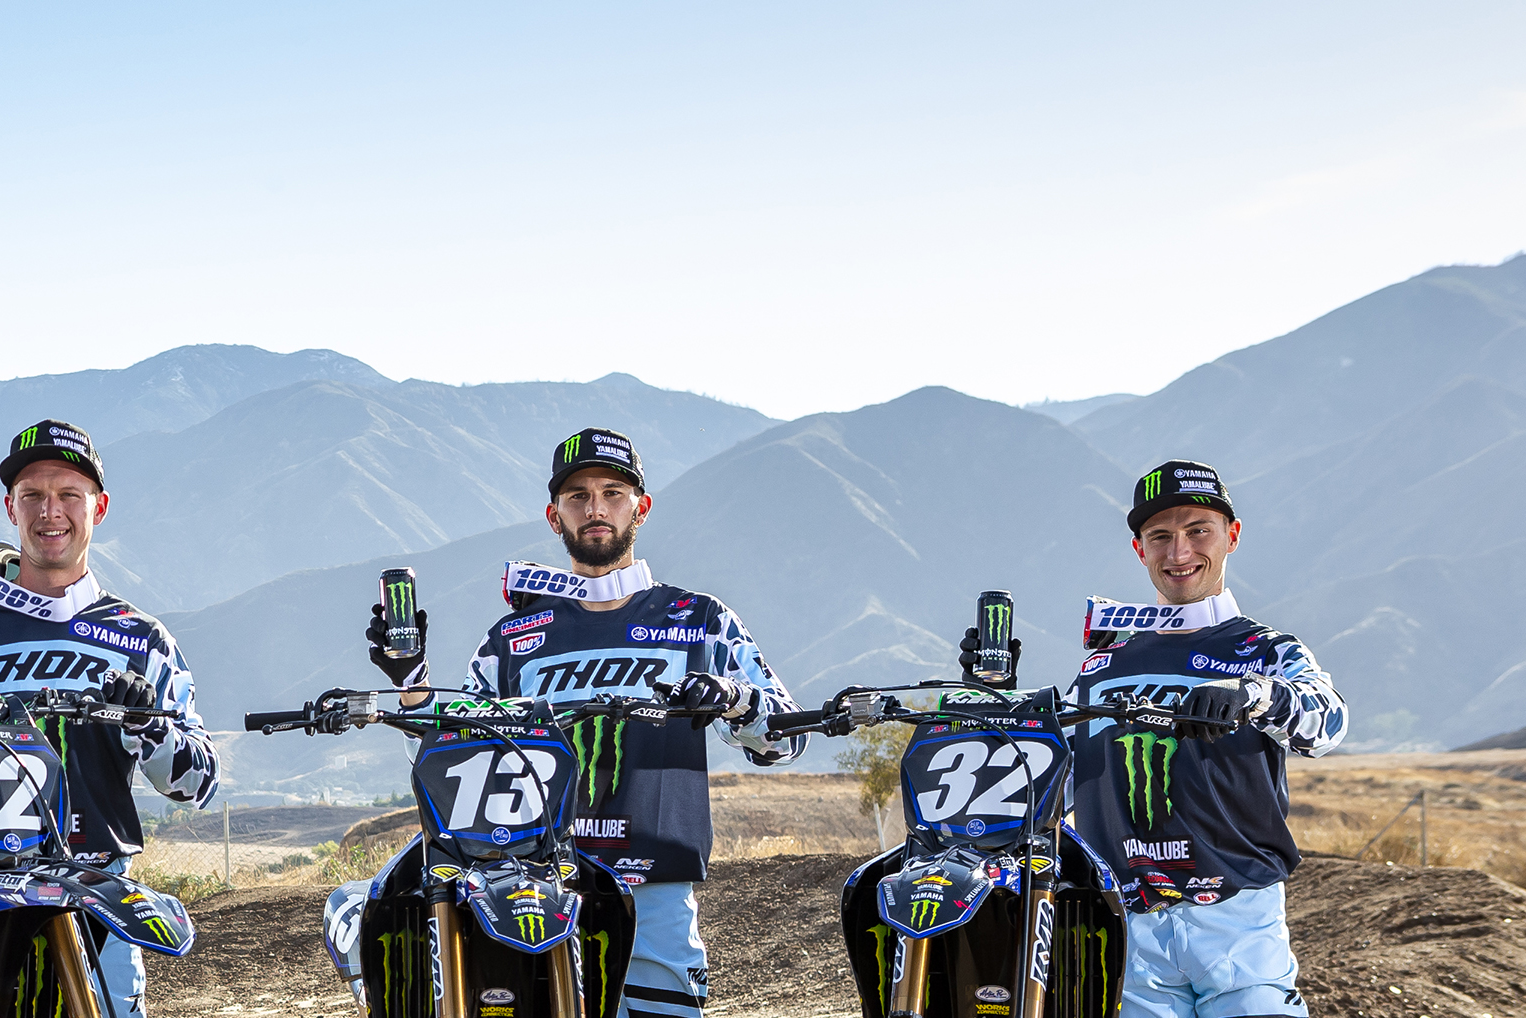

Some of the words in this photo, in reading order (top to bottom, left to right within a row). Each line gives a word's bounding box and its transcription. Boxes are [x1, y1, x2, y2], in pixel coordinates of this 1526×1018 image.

[59, 428, 88, 445] YAMAHA
[601, 435, 630, 450] YAMAHA
[596, 446, 630, 459] YAMALUBE
[1185, 469, 1217, 480] YAMAHA
[1179, 480, 1217, 491] YAMALUBE
[514, 568, 588, 600] 100%
[501, 610, 553, 632] PARTS
[1097, 605, 1185, 629] 100%
[501, 616, 554, 637] UNLIMITED
[649, 626, 706, 643] YAMAHA
[92, 624, 149, 654] YAMAHA
[514, 635, 544, 652] 100%
[1083, 655, 1108, 673] 100%
[1208, 657, 1263, 675] YAMAHA
[536, 657, 669, 698] THOR
[89, 709, 125, 721] ARC
[630, 707, 667, 720] ARC
[1135, 714, 1173, 727] ARC
[444, 749, 557, 831] 13
[916, 741, 1054, 823] 32
[573, 818, 627, 839] MALUBE
[910, 891, 945, 902] YAMAHA
[1197, 894, 1218, 903] BELL
[510, 905, 546, 916] YAMAHA
[479, 1006, 515, 1014] WORKS
[975, 1004, 1010, 1012] WORKS
